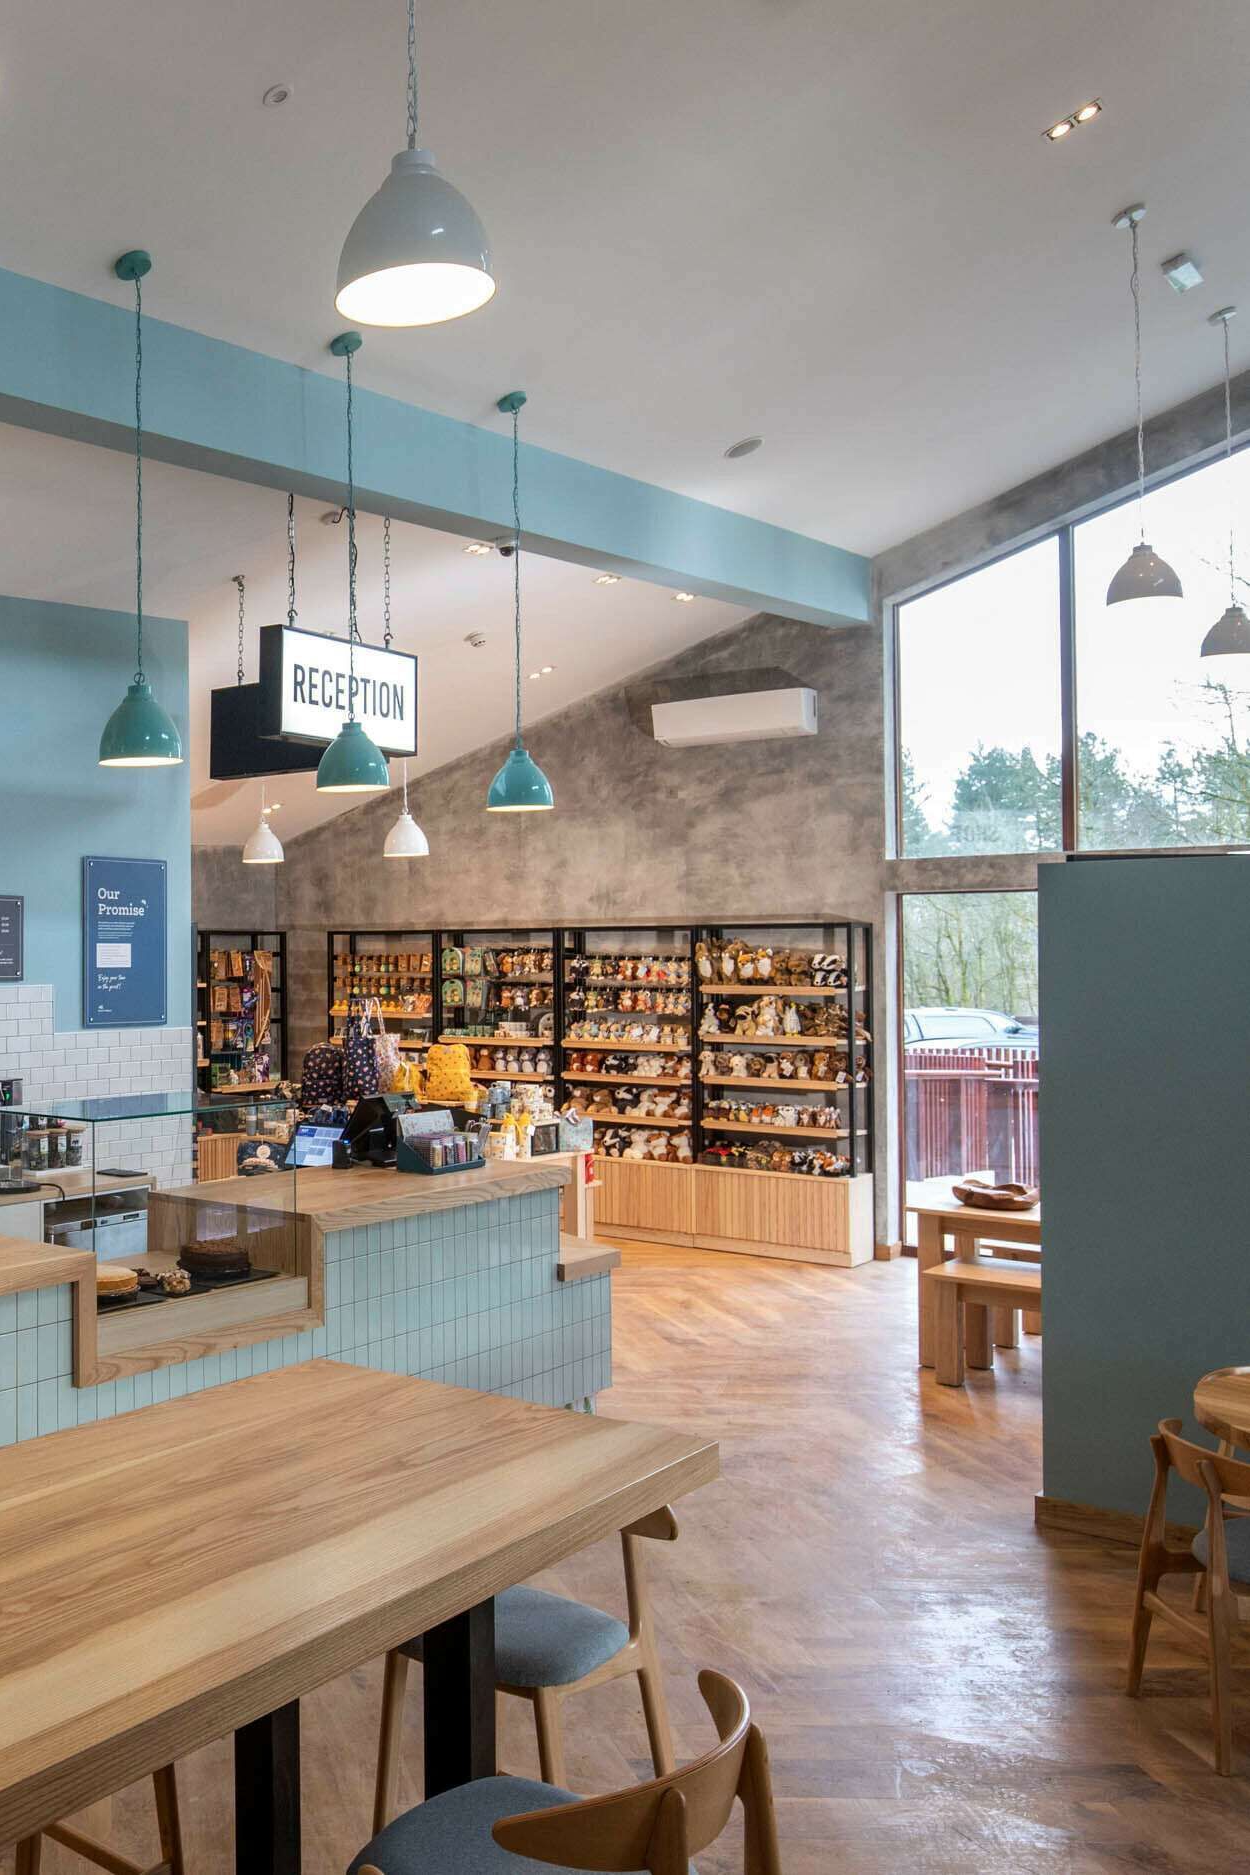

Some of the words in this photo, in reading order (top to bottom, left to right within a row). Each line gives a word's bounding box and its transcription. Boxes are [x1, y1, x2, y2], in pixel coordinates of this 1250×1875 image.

[293, 663, 404, 721] RECEPTION
[97, 887, 120, 900] Our
[97, 903, 145, 916] Promise
